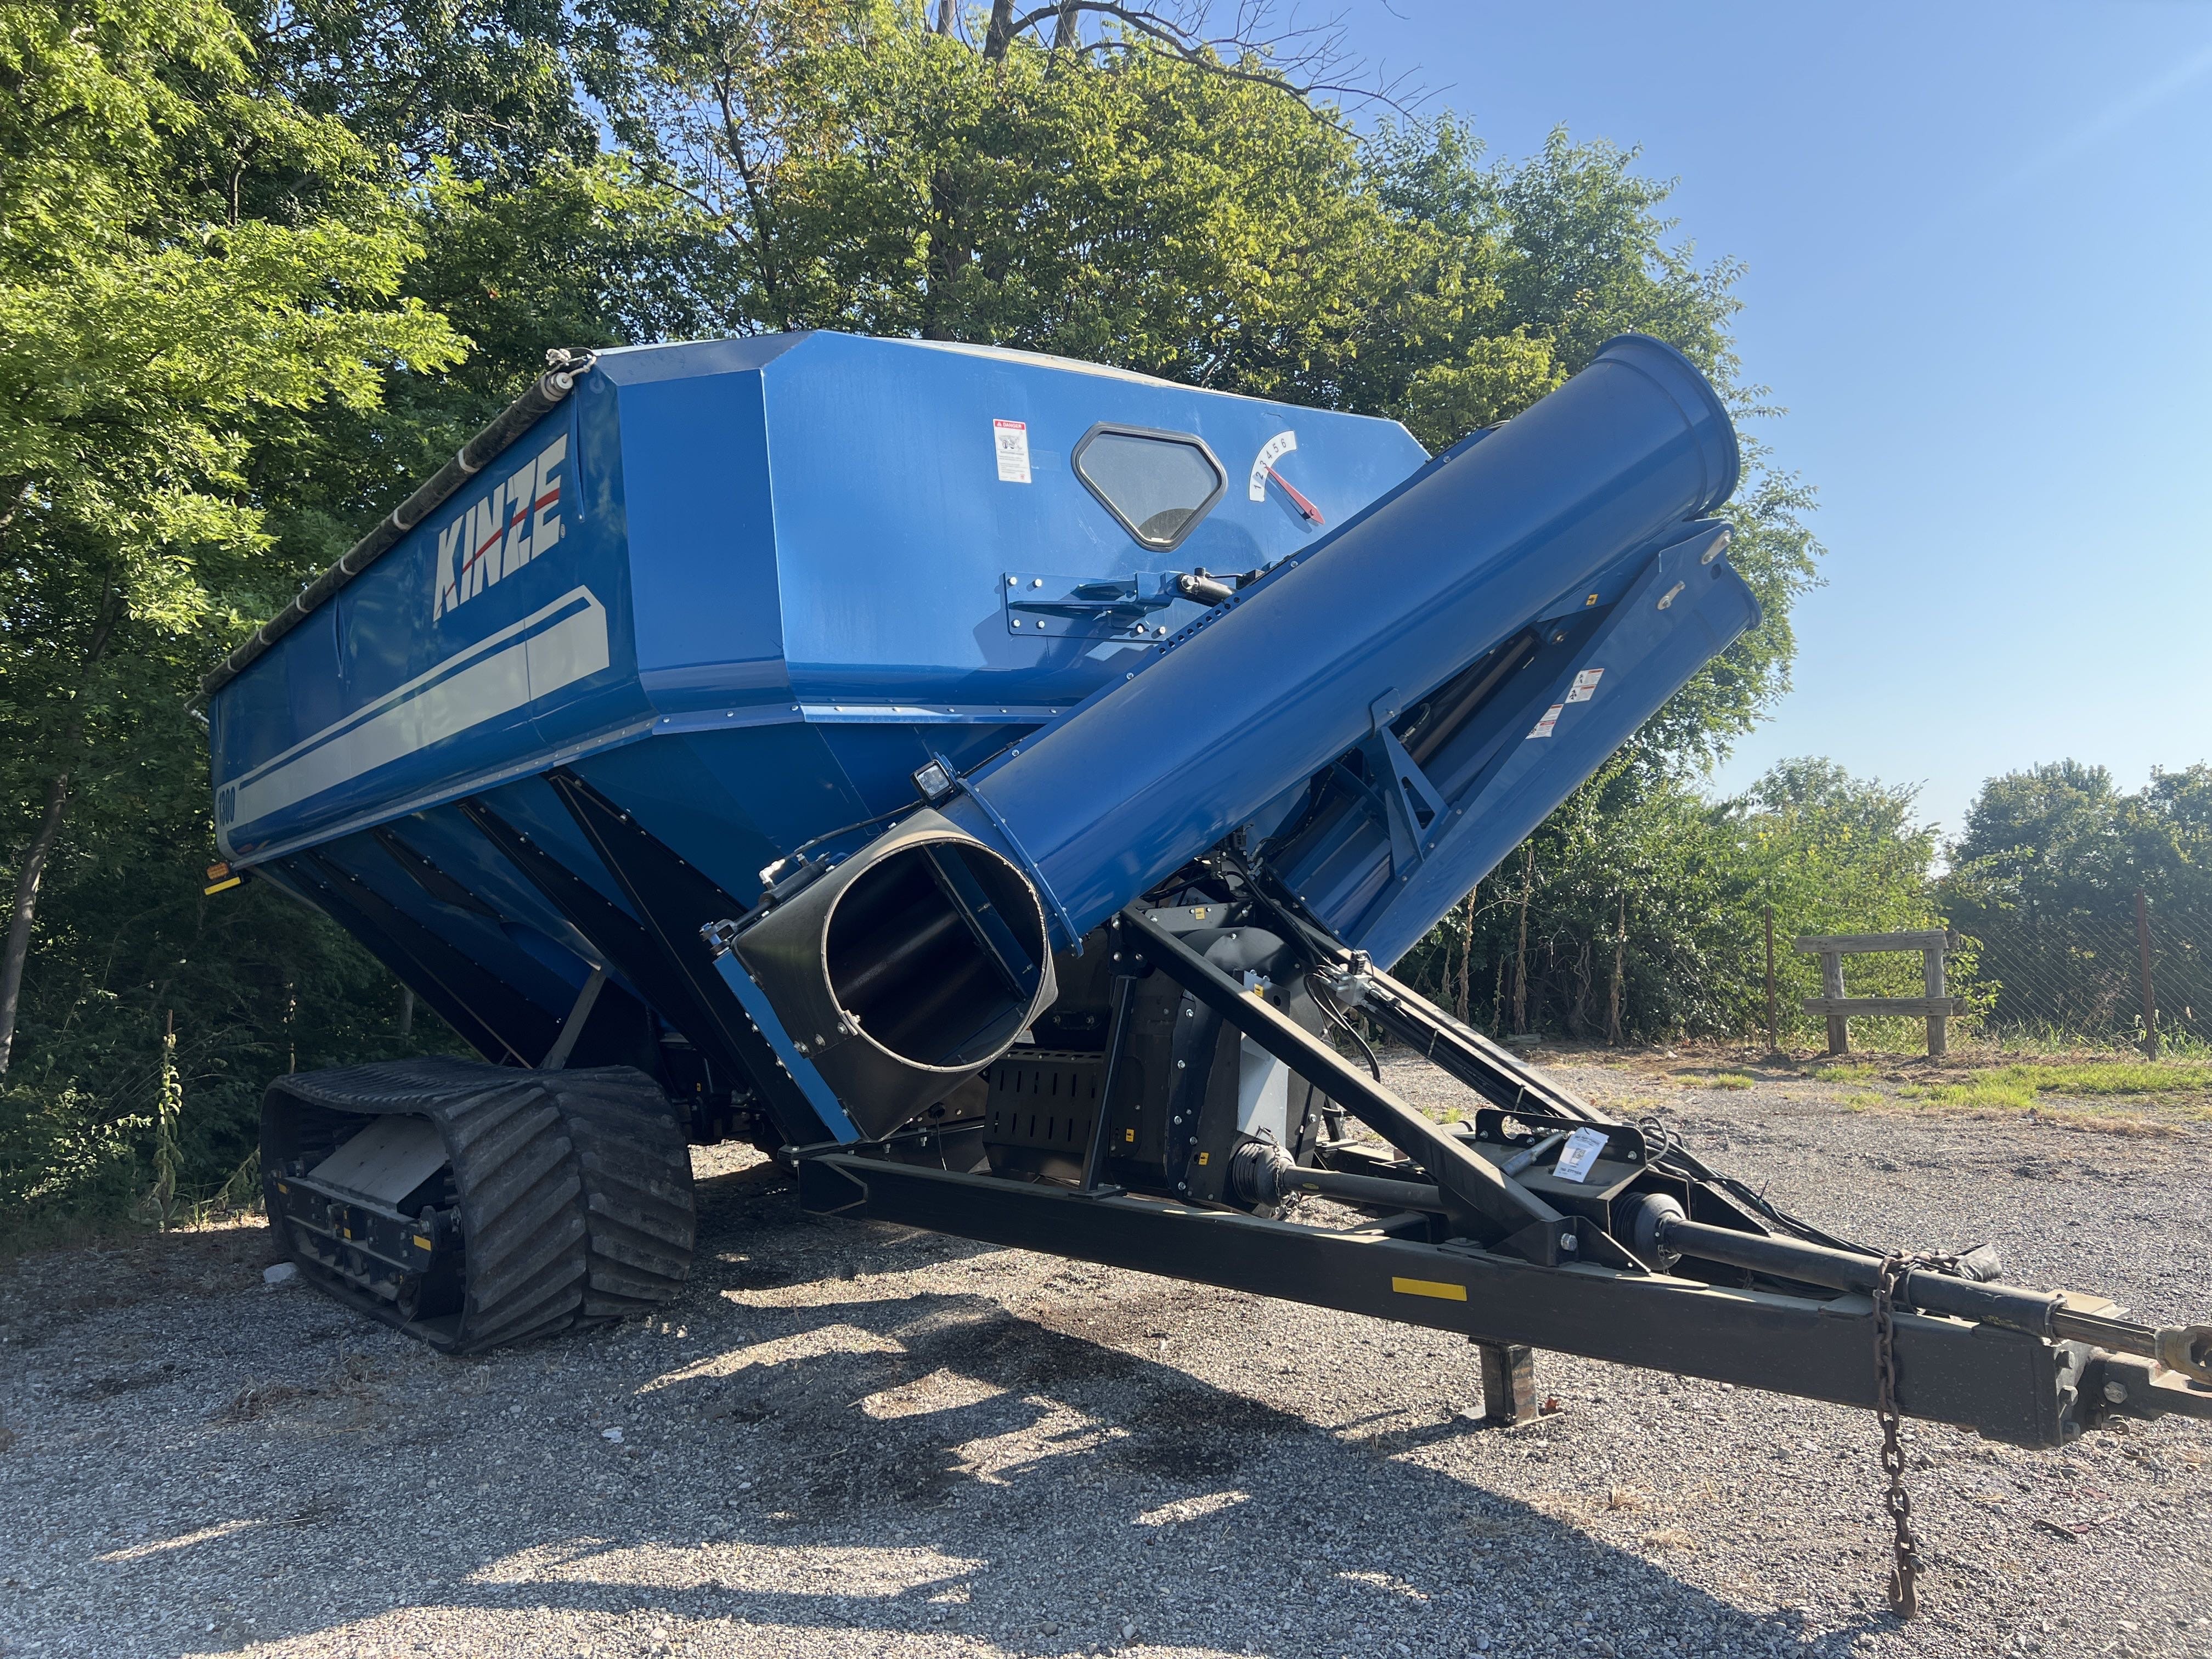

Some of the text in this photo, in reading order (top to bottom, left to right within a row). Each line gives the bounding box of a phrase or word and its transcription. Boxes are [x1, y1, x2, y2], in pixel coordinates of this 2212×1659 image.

[1260, 460, 1267, 469] 3
[1266, 450, 1273, 459] 4
[1272, 443, 1279, 453] 5
[1281, 438, 1286, 448] 6
[433, 433, 568, 622] KINZE
